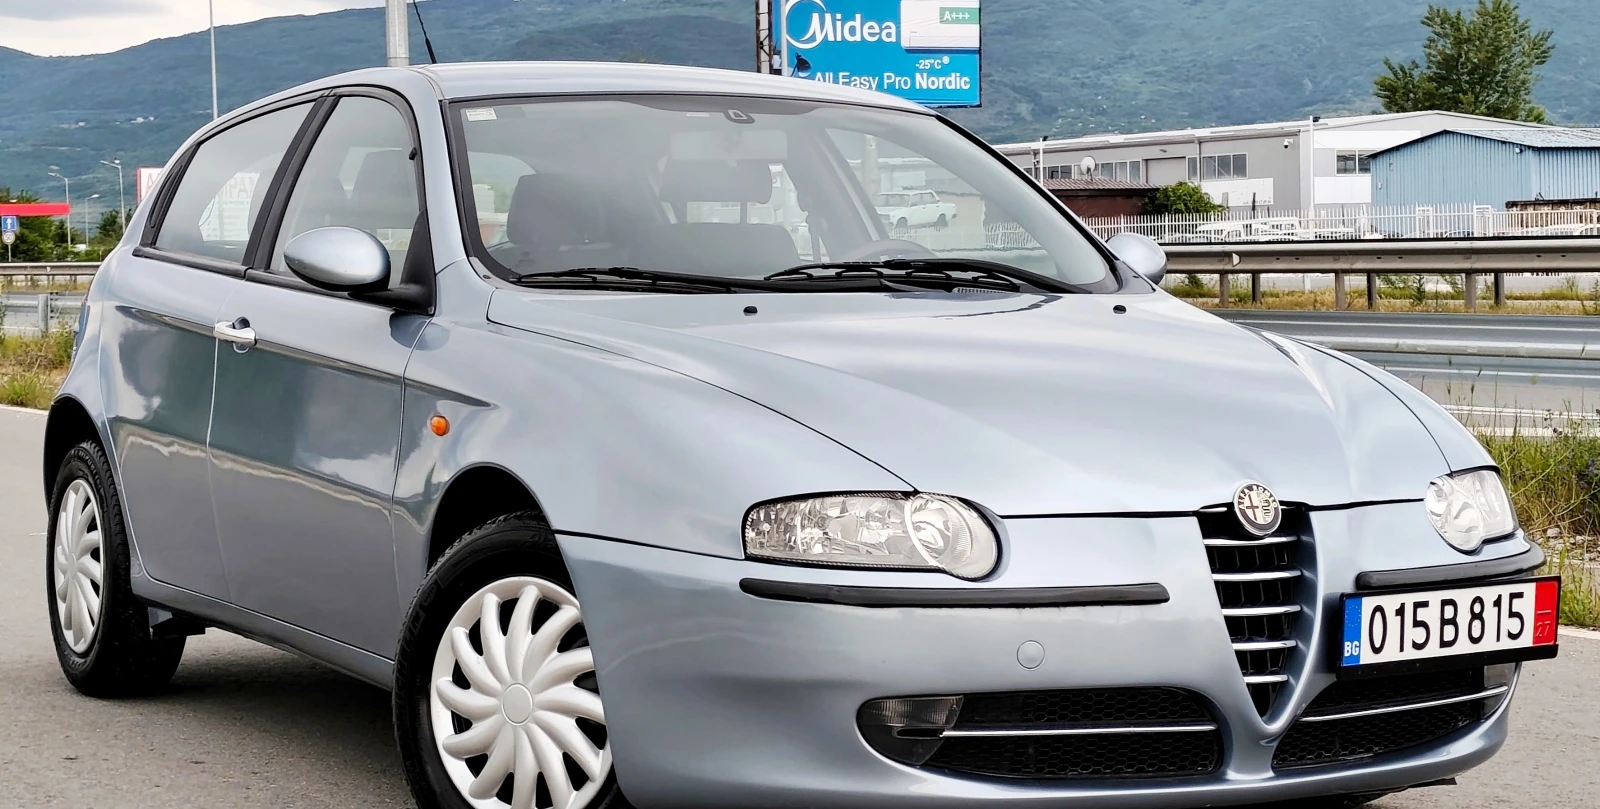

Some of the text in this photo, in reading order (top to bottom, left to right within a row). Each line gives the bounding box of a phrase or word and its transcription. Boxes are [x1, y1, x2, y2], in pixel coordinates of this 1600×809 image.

[943, 11, 970, 22] A+++
[800, 12, 897, 43] Midea
[838, 72, 879, 91] Easy
[883, 72, 911, 90] Pro
[915, 72, 971, 90] Nordic
[1344, 641, 1360, 657] BG
